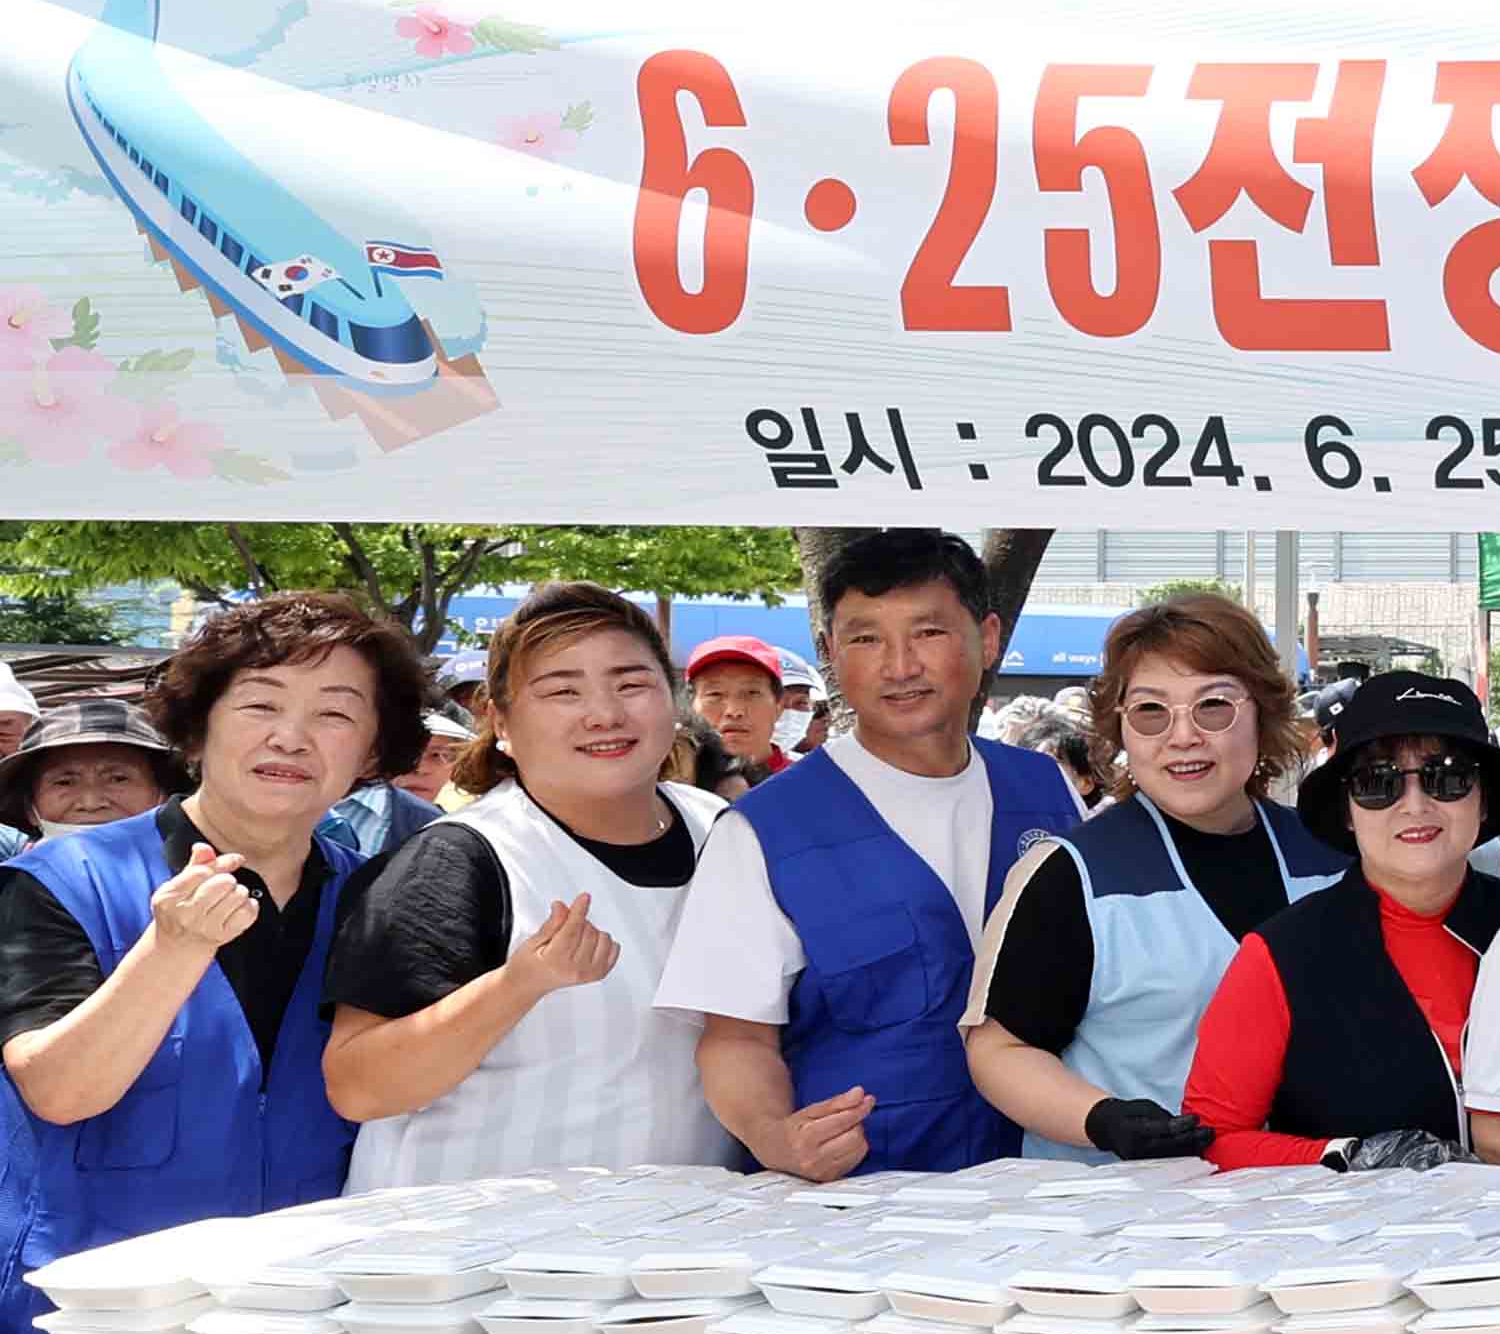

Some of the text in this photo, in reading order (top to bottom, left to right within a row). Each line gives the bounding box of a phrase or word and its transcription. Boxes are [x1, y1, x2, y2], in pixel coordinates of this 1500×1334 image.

[744, 407, 923, 491] 일시
[1024, 413, 1273, 493] 2024.
[1303, 415, 1392, 493] 6.
